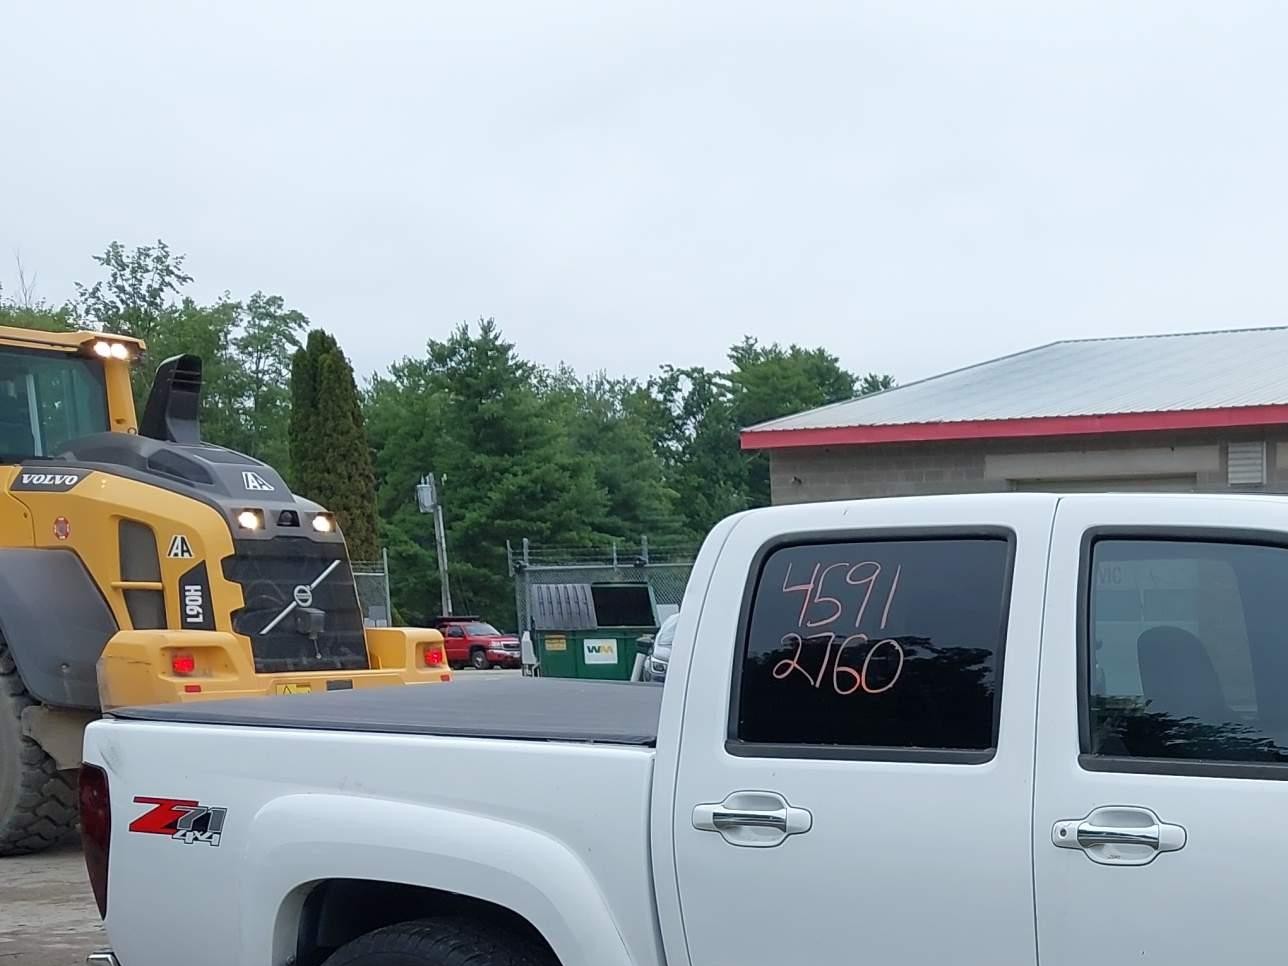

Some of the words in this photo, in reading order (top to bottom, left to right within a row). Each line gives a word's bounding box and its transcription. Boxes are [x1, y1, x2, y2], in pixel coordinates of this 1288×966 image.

[21, 473, 79, 486] VOLVO
[184, 584, 204, 624] L90H
[782, 562, 901, 629] 4591
[586, 645, 614, 655] WM
[772, 631, 904, 695] 2760
[128, 796, 228, 836] Z71
